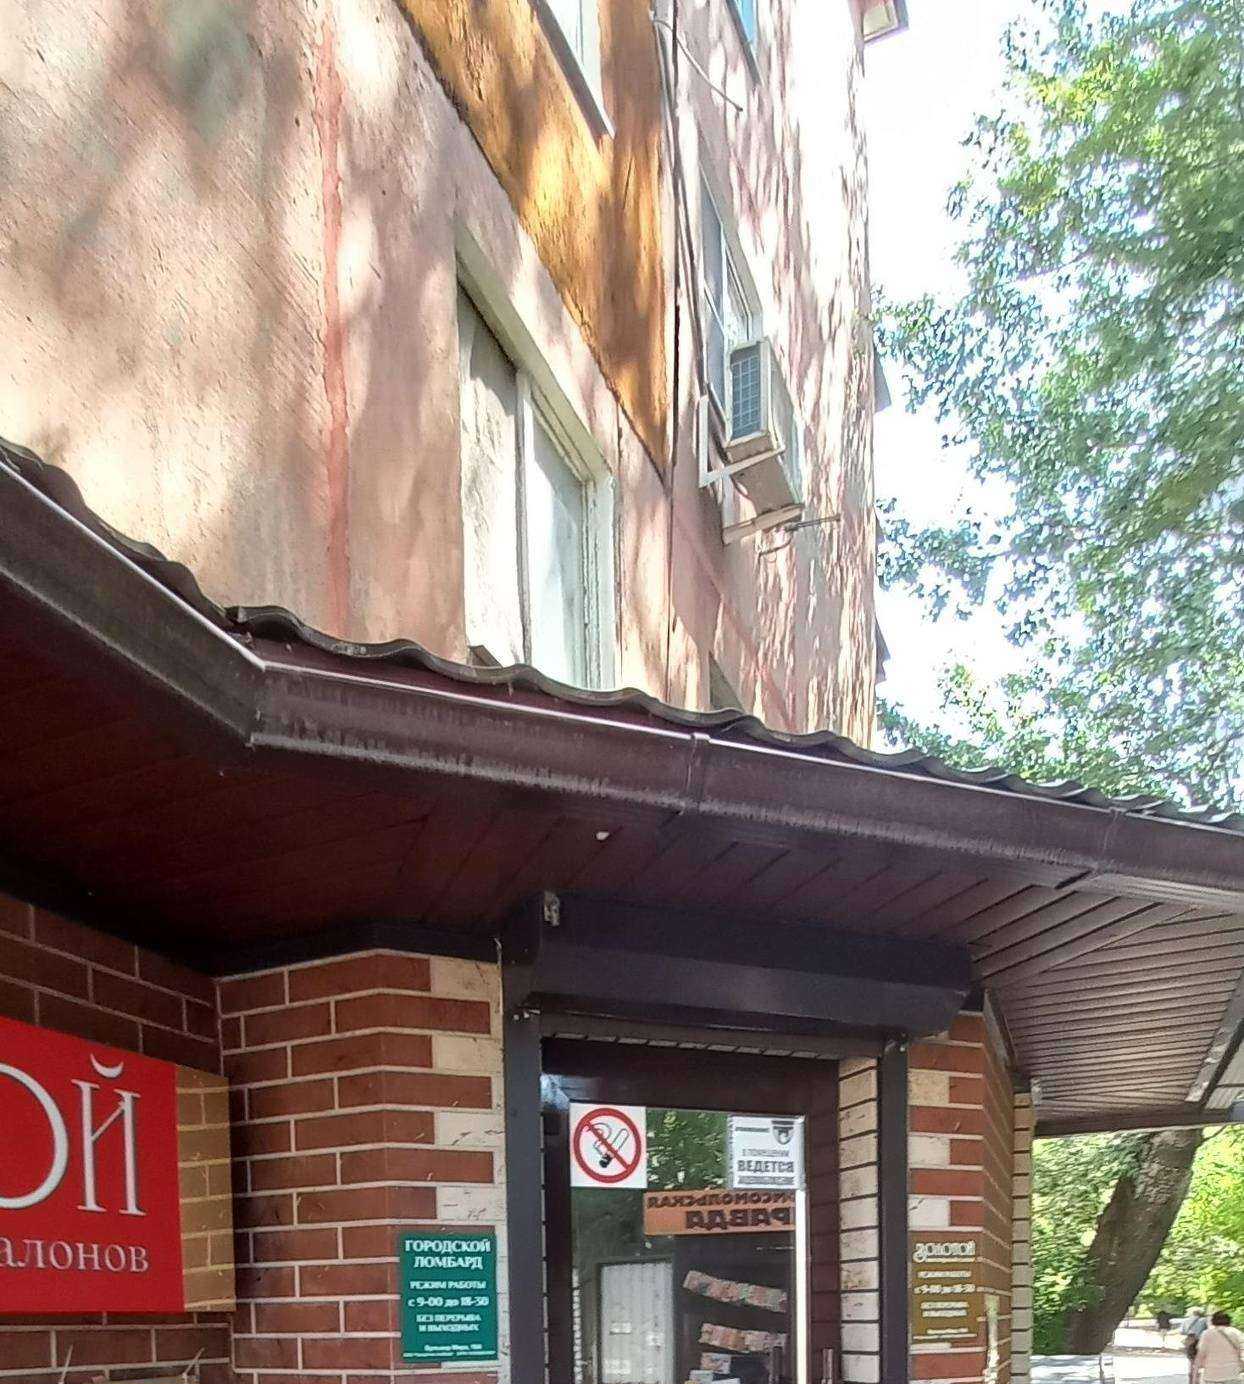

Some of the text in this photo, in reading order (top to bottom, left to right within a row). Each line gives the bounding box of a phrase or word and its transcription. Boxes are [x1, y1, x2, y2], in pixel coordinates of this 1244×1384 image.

[738, 1160, 794, 1173] ВЕДЕТСЯ
[405, 1239, 491, 1254] ГОРОДСКОЙ
[413, 1256, 484, 1270] ЛОМБАРД
[409, 1281, 486, 1290] РЕЖИМ РАБОТЫ
[408, 1299, 415, 1307] с
[416, 1296, 443, 1307] 9-00
[444, 1299, 459, 1307] до
[416, 1314, 433, 1322] БЕЗ
